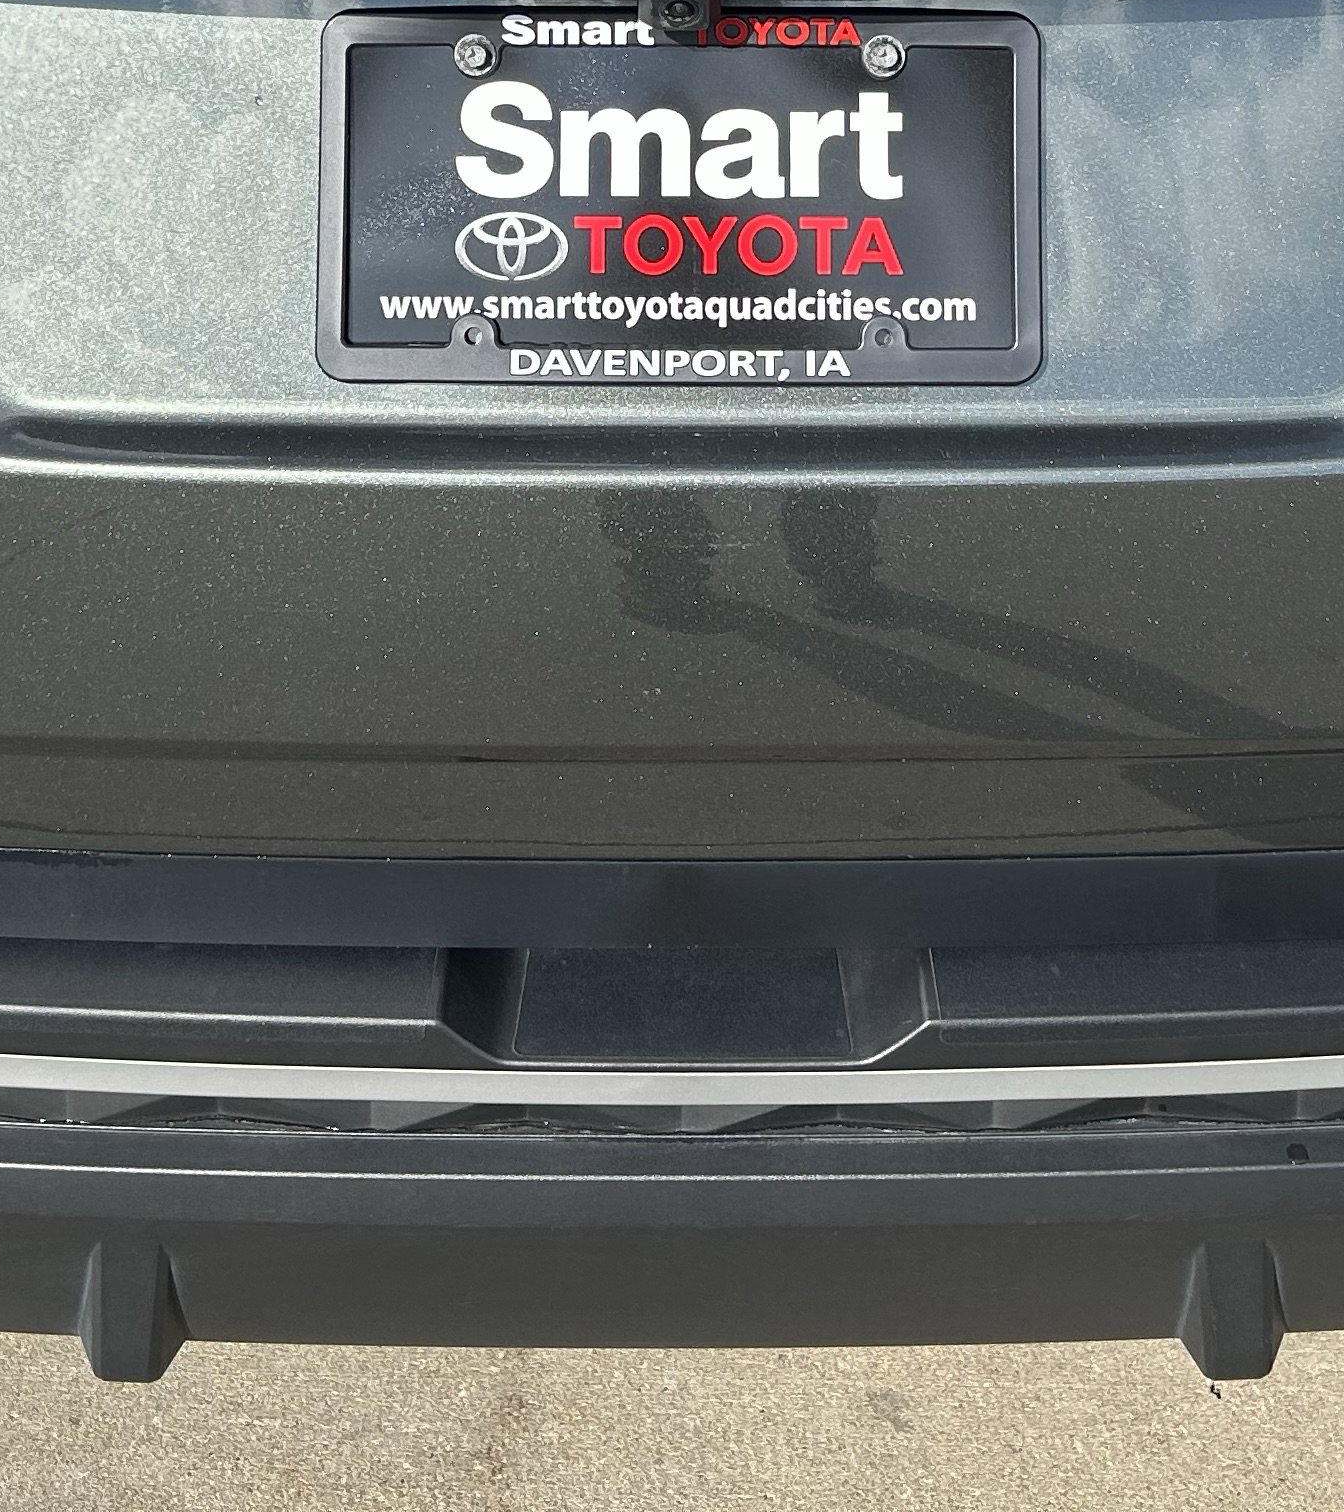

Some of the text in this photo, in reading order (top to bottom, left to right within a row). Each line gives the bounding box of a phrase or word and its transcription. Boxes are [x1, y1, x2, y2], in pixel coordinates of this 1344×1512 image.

[501, 14, 655, 47] Smart
[455, 80, 904, 200] Smart
[573, 214, 905, 277] TOYOTA
[379, 289, 977, 328] www.smarttoyotaquadcities.com
[509, 349, 851, 383] DAVENPORT, IA
